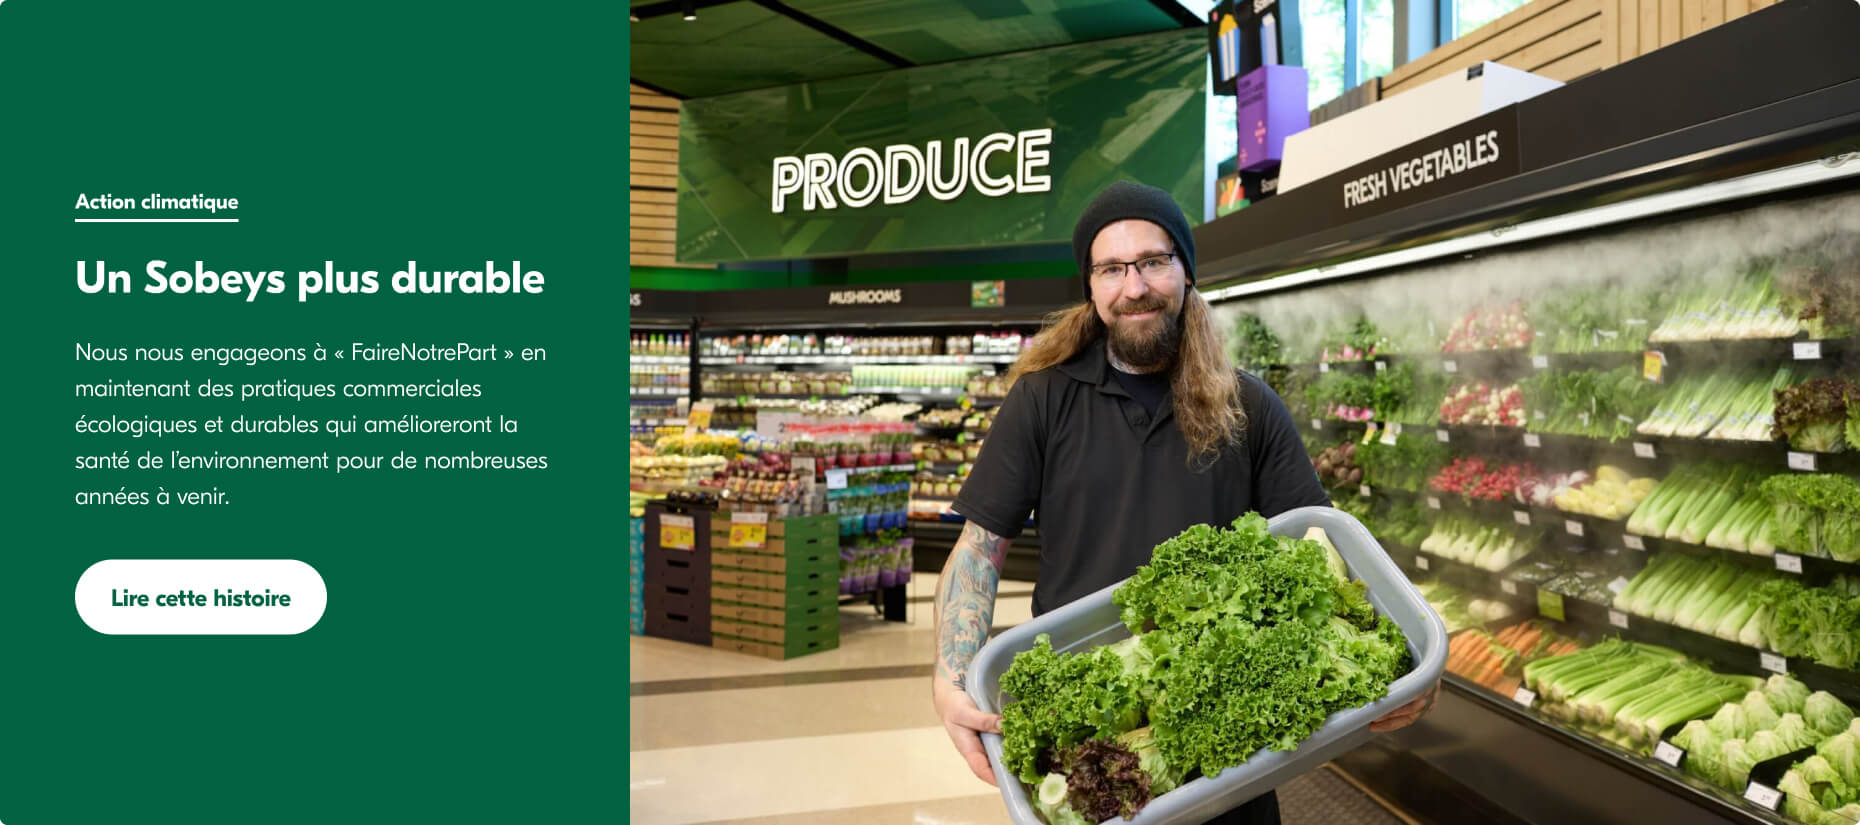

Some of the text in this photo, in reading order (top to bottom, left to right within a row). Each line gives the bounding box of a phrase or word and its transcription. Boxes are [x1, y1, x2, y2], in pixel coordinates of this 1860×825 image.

[772, 128, 1052, 213] PRODUCE
[1343, 130, 1500, 209] FRESH VEGETABLES
[829, 289, 902, 305] MUSHROOMS
